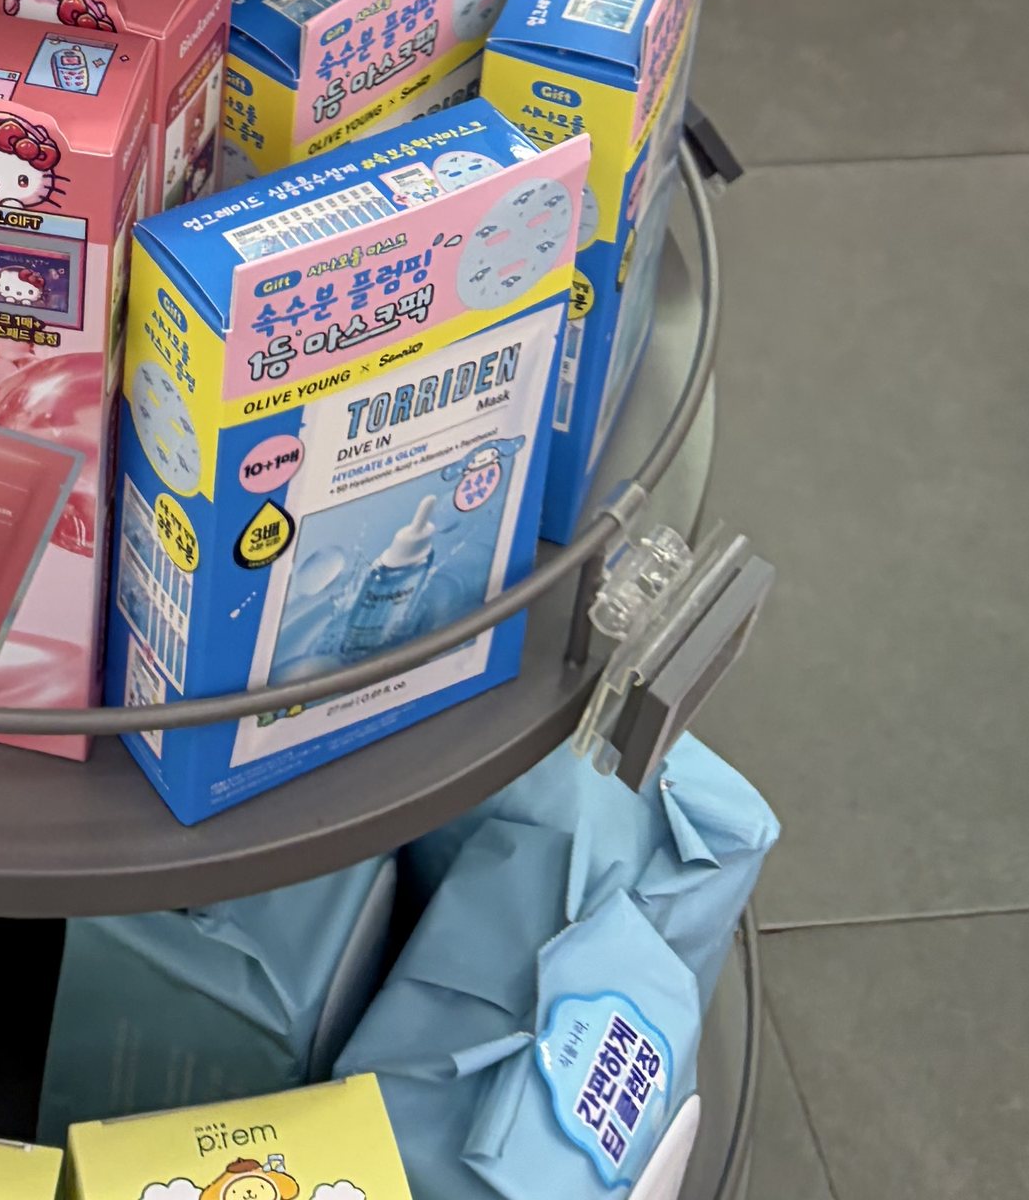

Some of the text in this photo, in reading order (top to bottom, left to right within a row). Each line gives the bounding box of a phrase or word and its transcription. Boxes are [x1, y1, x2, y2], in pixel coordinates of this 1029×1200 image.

[313, 78, 346, 123] 1등
[350, 20, 438, 91] 마스크팩
[316, 26, 375, 79] 속수분
[541, 86, 572, 102] Gift
[308, 105, 383, 155] OLIVE YOUNG
[8, 214, 41, 229] GIFT
[183, 198, 265, 231] 업그레이드
[262, 233, 407, 293] Gift 시나모롤 마스크
[252, 249, 432, 337] 속수분 플럼핑
[248, 283, 434, 381] 1등 마스크팩
[244, 390, 292, 415] OLIVE
[297, 370, 351, 399] YOUNG
[347, 343, 521, 440] TORRIDEN
[476, 389, 510, 412] Mask
[243, 449, 300, 479] 10+1매
[337, 434, 391, 462] DIVE IN
[332, 460, 384, 484] HYDRATE
[249, 522, 280, 544] 3배
[576, 1015, 638, 1130] 간편하게
[601, 1039, 661, 1163] 딥 클렌징
